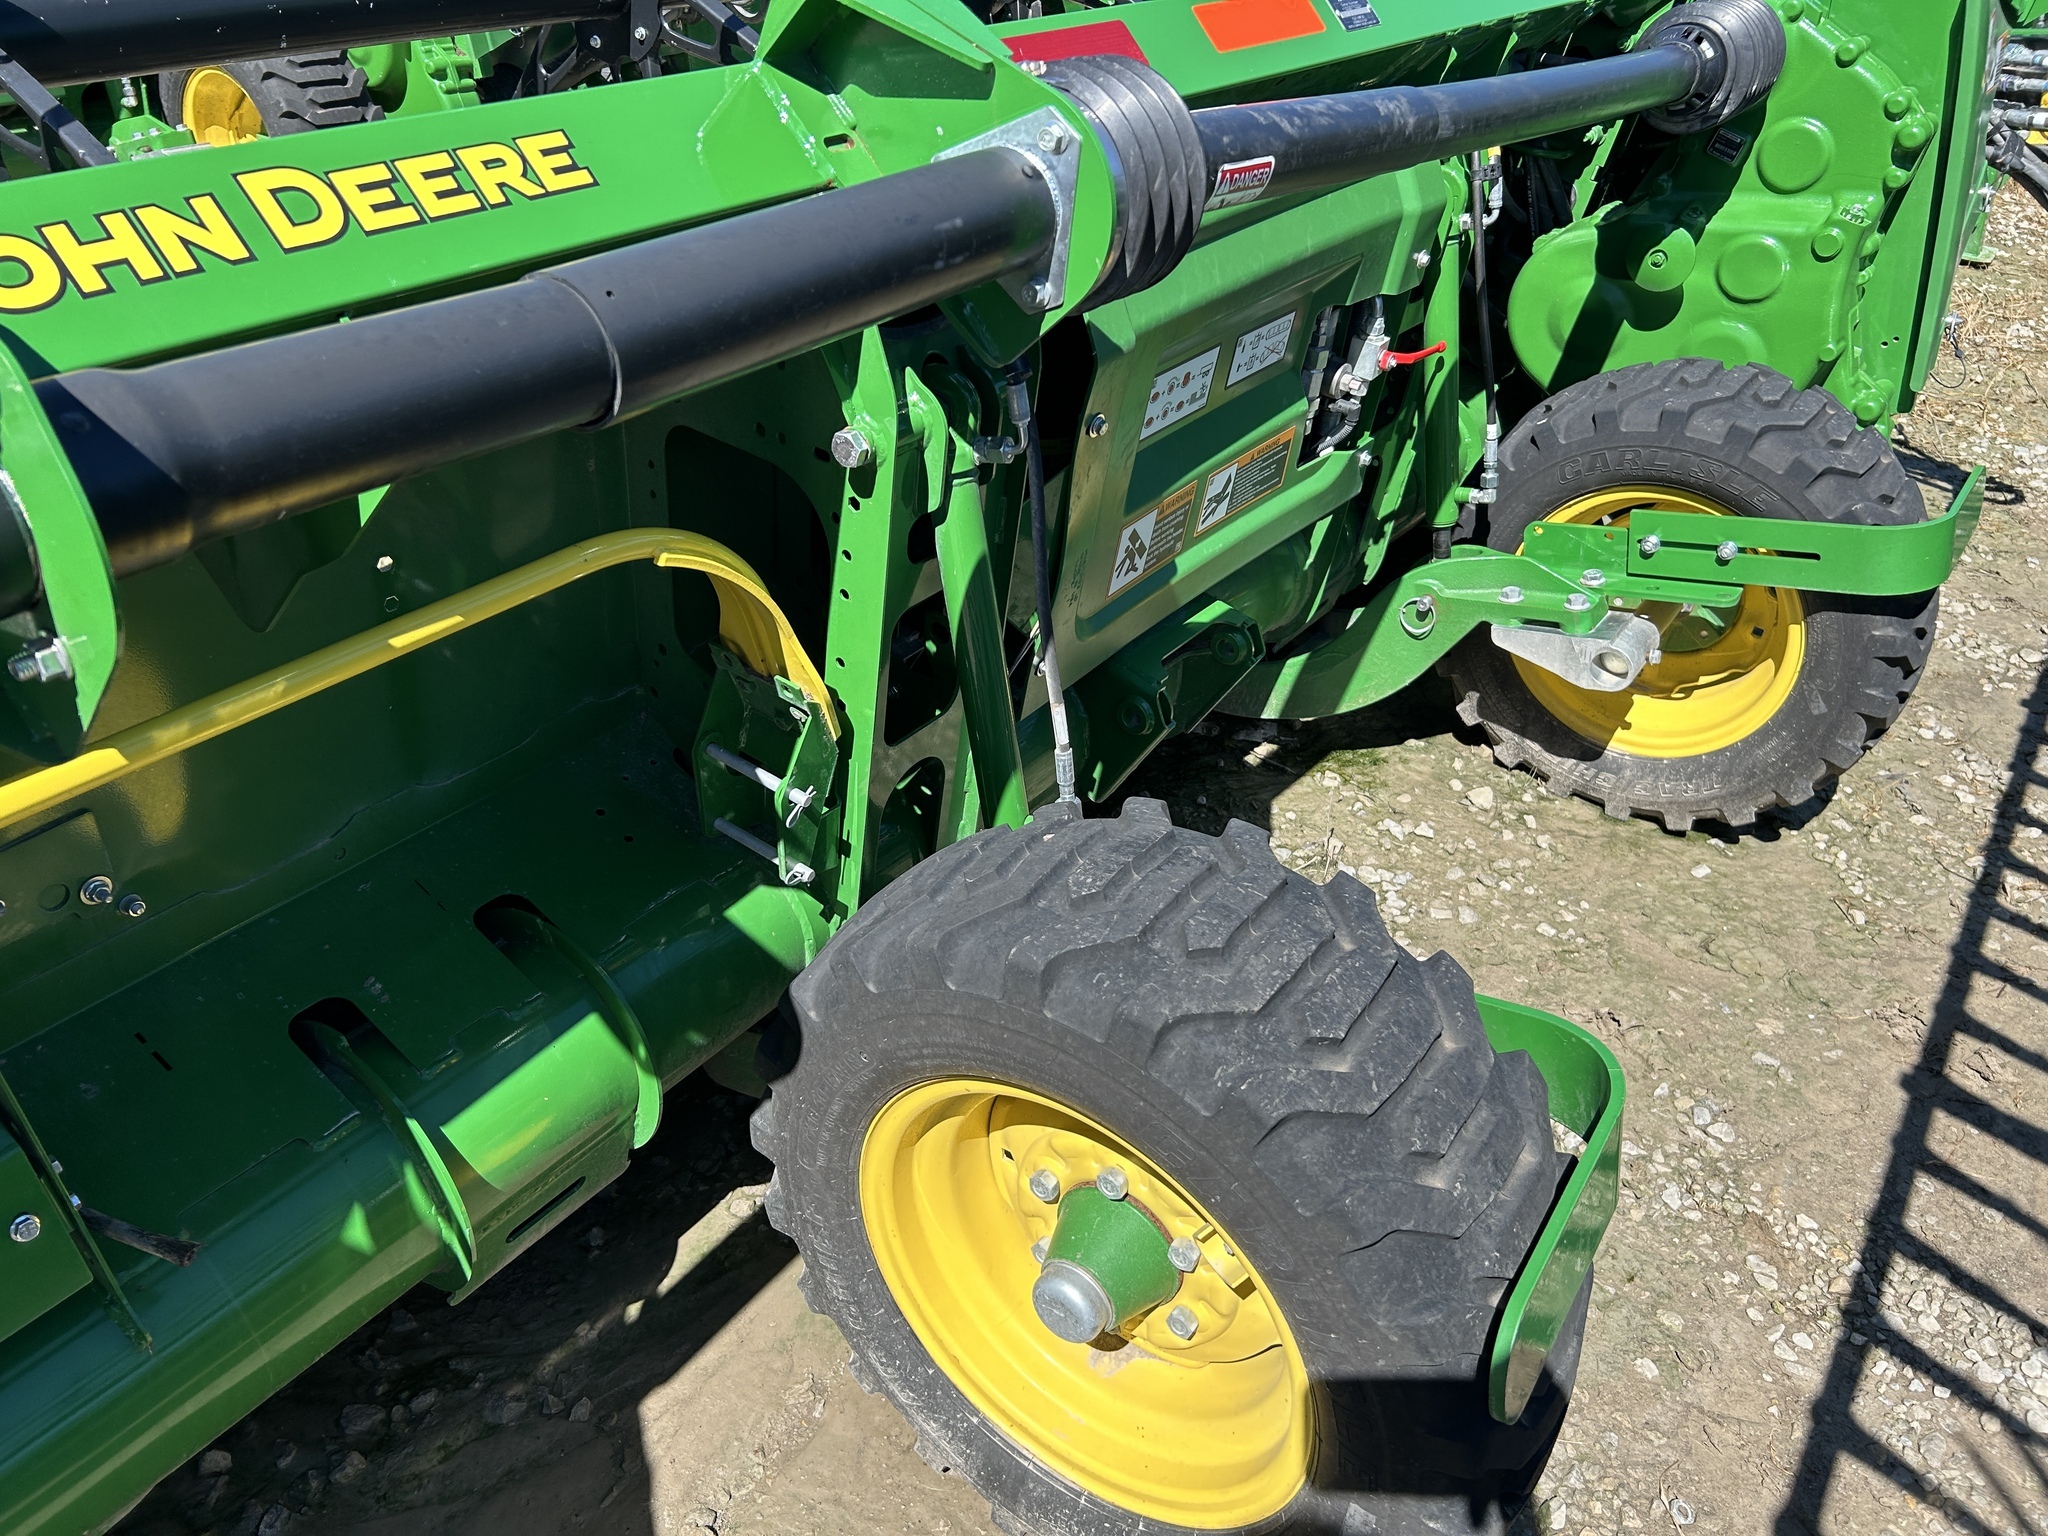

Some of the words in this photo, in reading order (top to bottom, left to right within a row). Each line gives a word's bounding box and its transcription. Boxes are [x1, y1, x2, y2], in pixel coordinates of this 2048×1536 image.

[234, 129, 600, 254] DEERE
[1229, 167, 1270, 191] DANGER
[1256, 438, 1281, 457] WARNING
[1557, 445, 1780, 513] CARLISLE
[1165, 486, 1195, 512] WARNING
